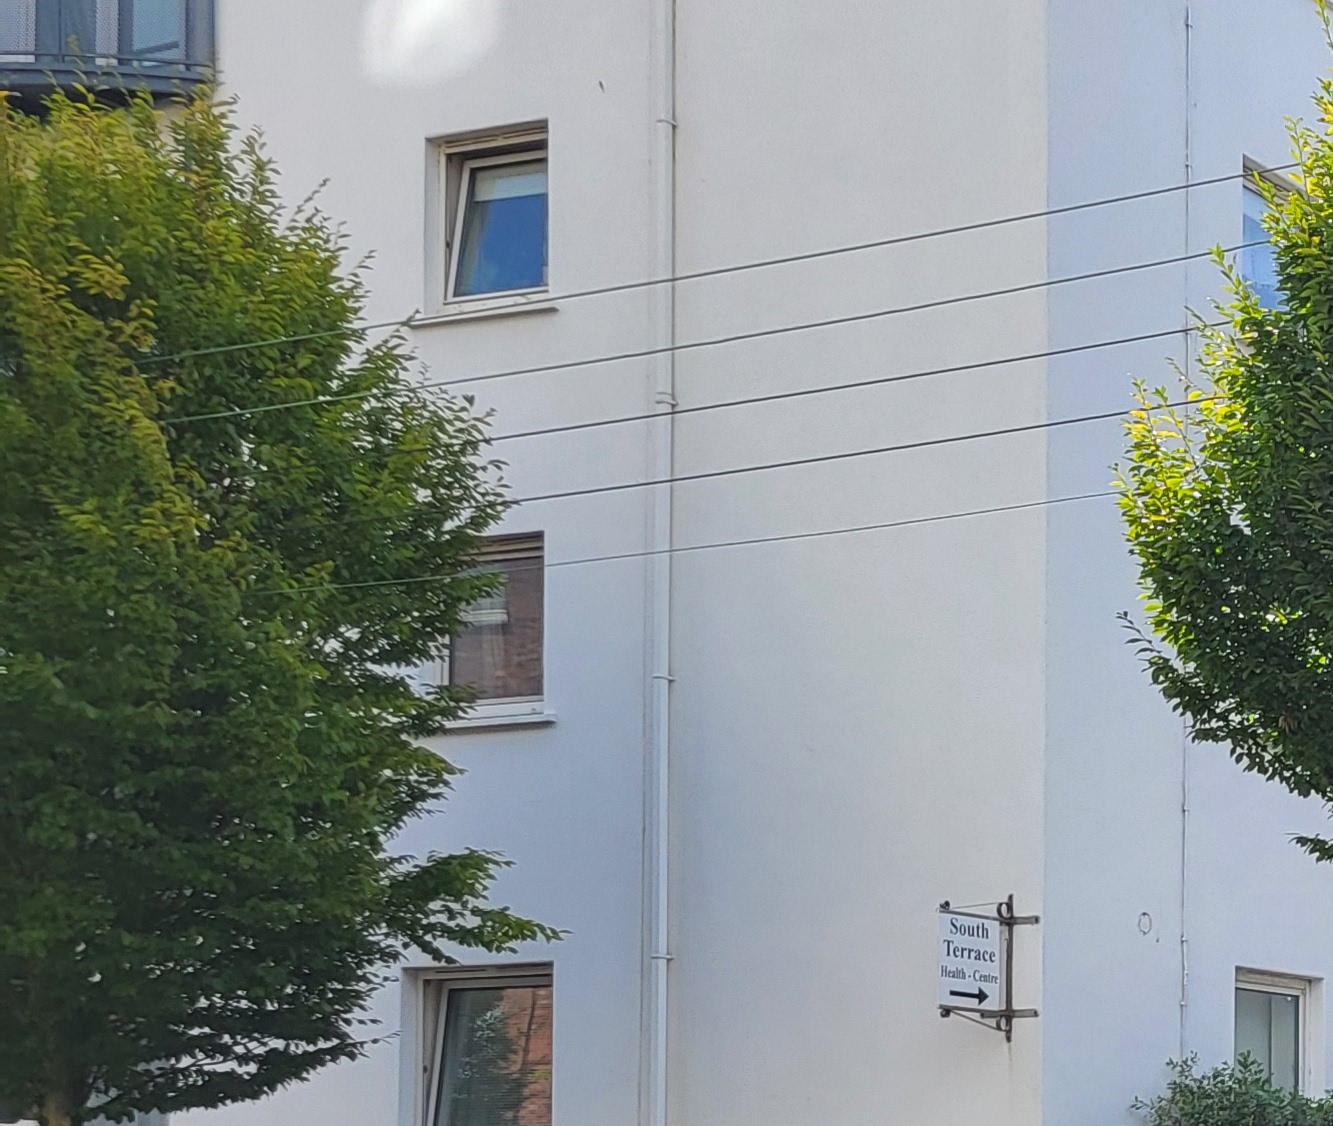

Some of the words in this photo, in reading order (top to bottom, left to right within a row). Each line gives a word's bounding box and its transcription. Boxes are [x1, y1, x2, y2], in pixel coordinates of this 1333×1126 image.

[950, 917, 989, 939] South
[943, 939, 996, 963] Terrace
[940, 965, 966, 980] Health
[972, 969, 998, 985] Centre
